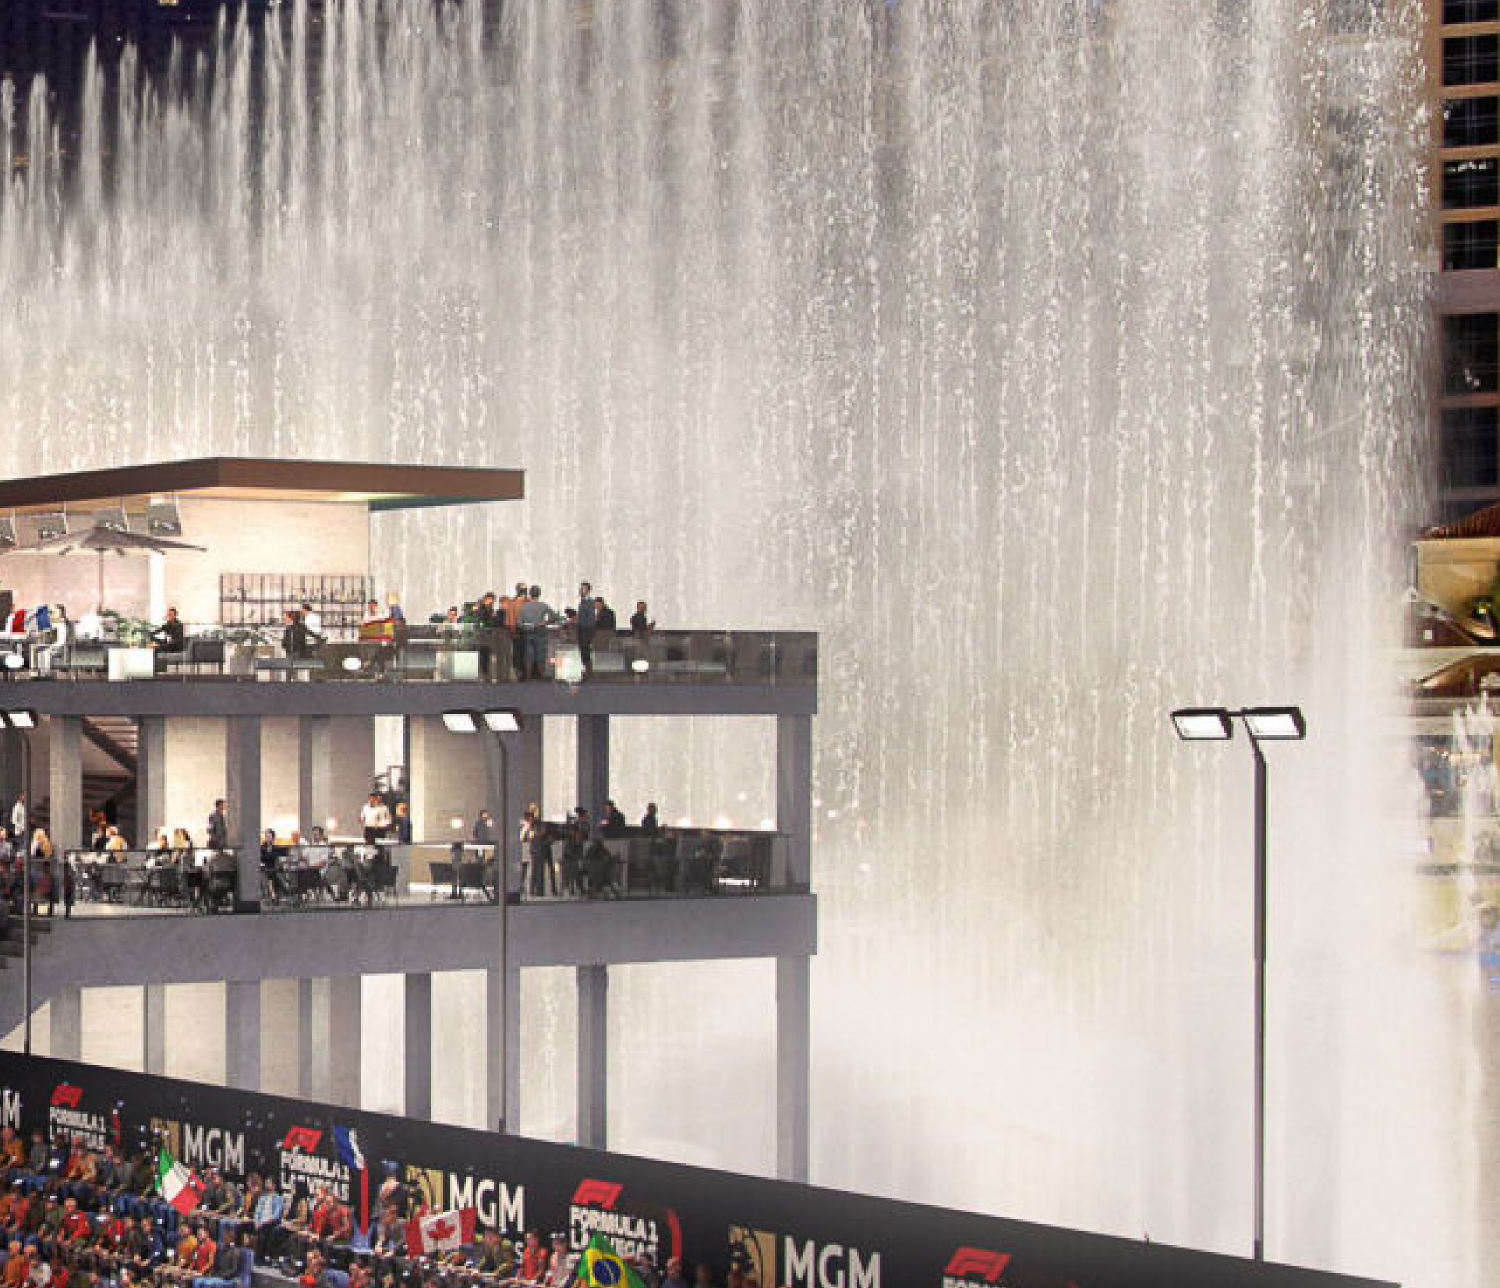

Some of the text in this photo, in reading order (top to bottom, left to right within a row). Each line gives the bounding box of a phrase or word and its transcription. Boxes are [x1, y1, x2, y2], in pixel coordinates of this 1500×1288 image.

[184, 1123, 245, 1176] MGM
[450, 1172, 525, 1233] MGM
[570, 1205, 647, 1241] FORMULA
